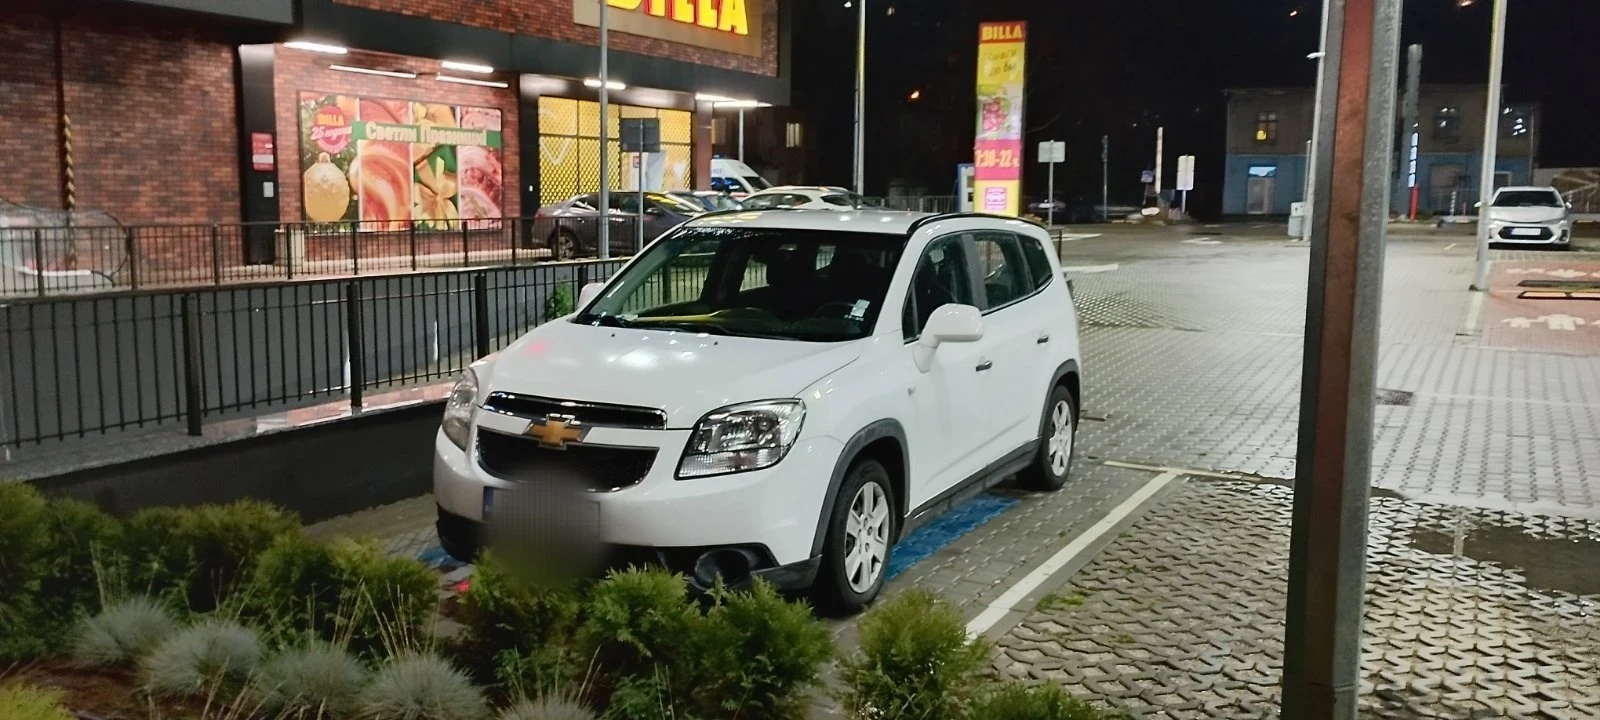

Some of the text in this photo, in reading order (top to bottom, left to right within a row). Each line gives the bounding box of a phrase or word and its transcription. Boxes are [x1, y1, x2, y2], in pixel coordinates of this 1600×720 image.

[606, 0, 748, 35] LLA
[982, 25, 1022, 40] BILLA
[311, 125, 325, 140] 25
